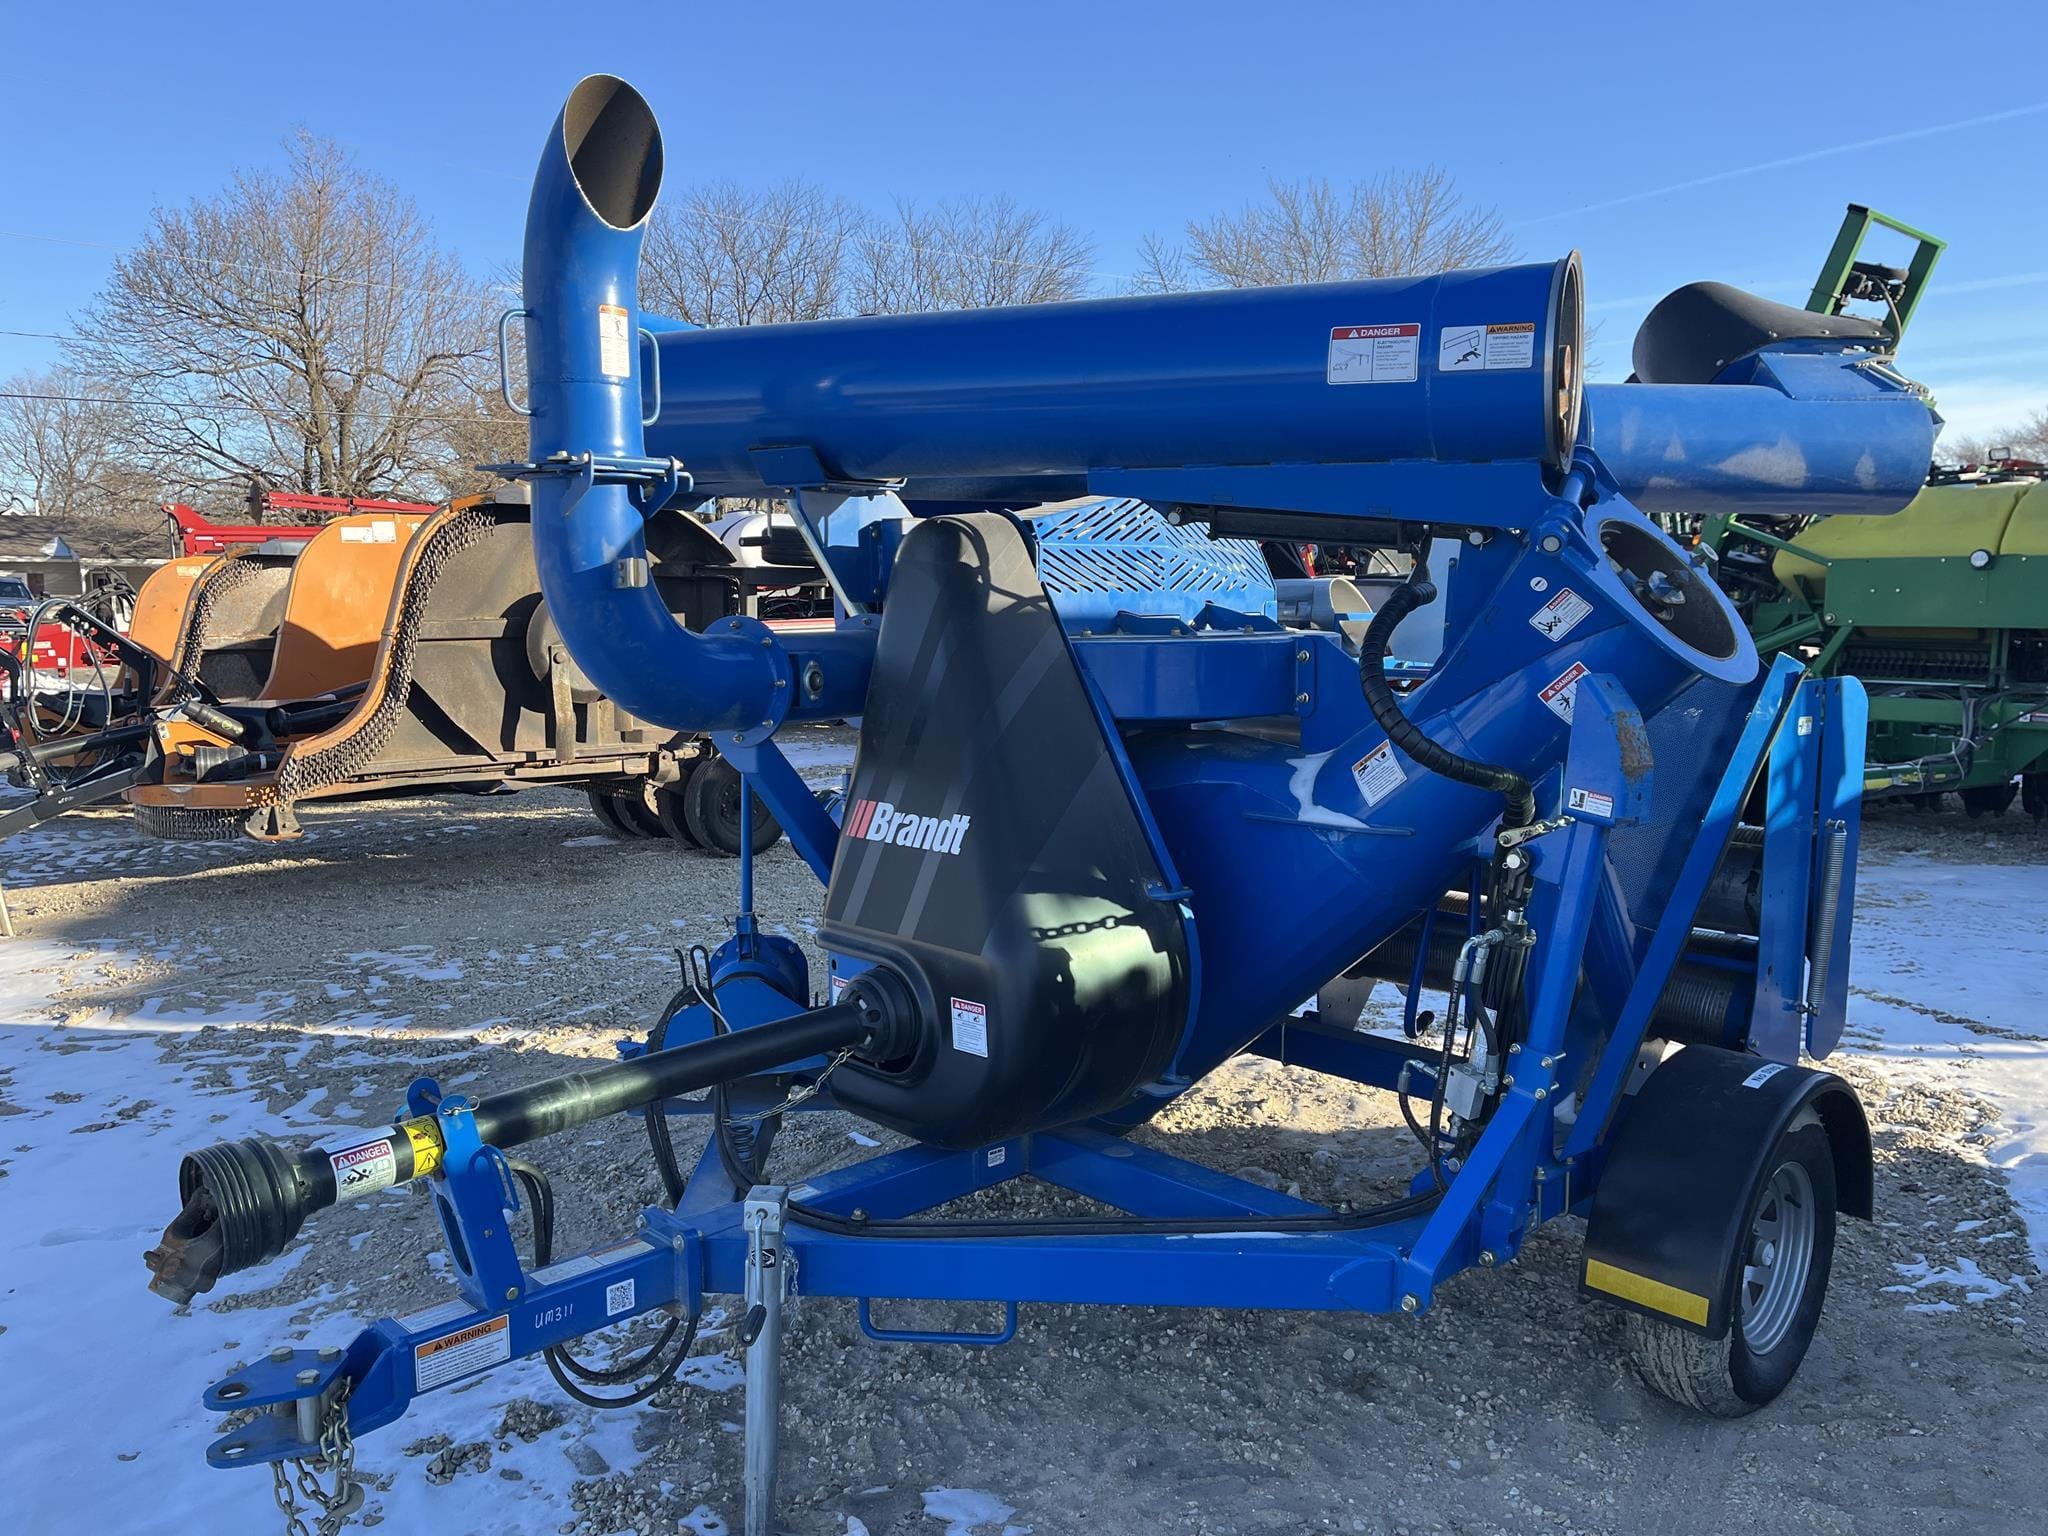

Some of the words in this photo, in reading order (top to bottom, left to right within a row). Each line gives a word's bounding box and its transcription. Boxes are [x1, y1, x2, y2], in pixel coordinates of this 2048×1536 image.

[1360, 327, 1401, 337] DANGER
[1497, 324, 1533, 333] WARNING
[1554, 670, 1579, 691] DANGER
[866, 801, 971, 855] Brandt
[1750, 1073, 1767, 1082] No
[349, 1143, 389, 1164] DANGER
[535, 1303, 573, 1329] UM311
[444, 1324, 492, 1348] WARNING
